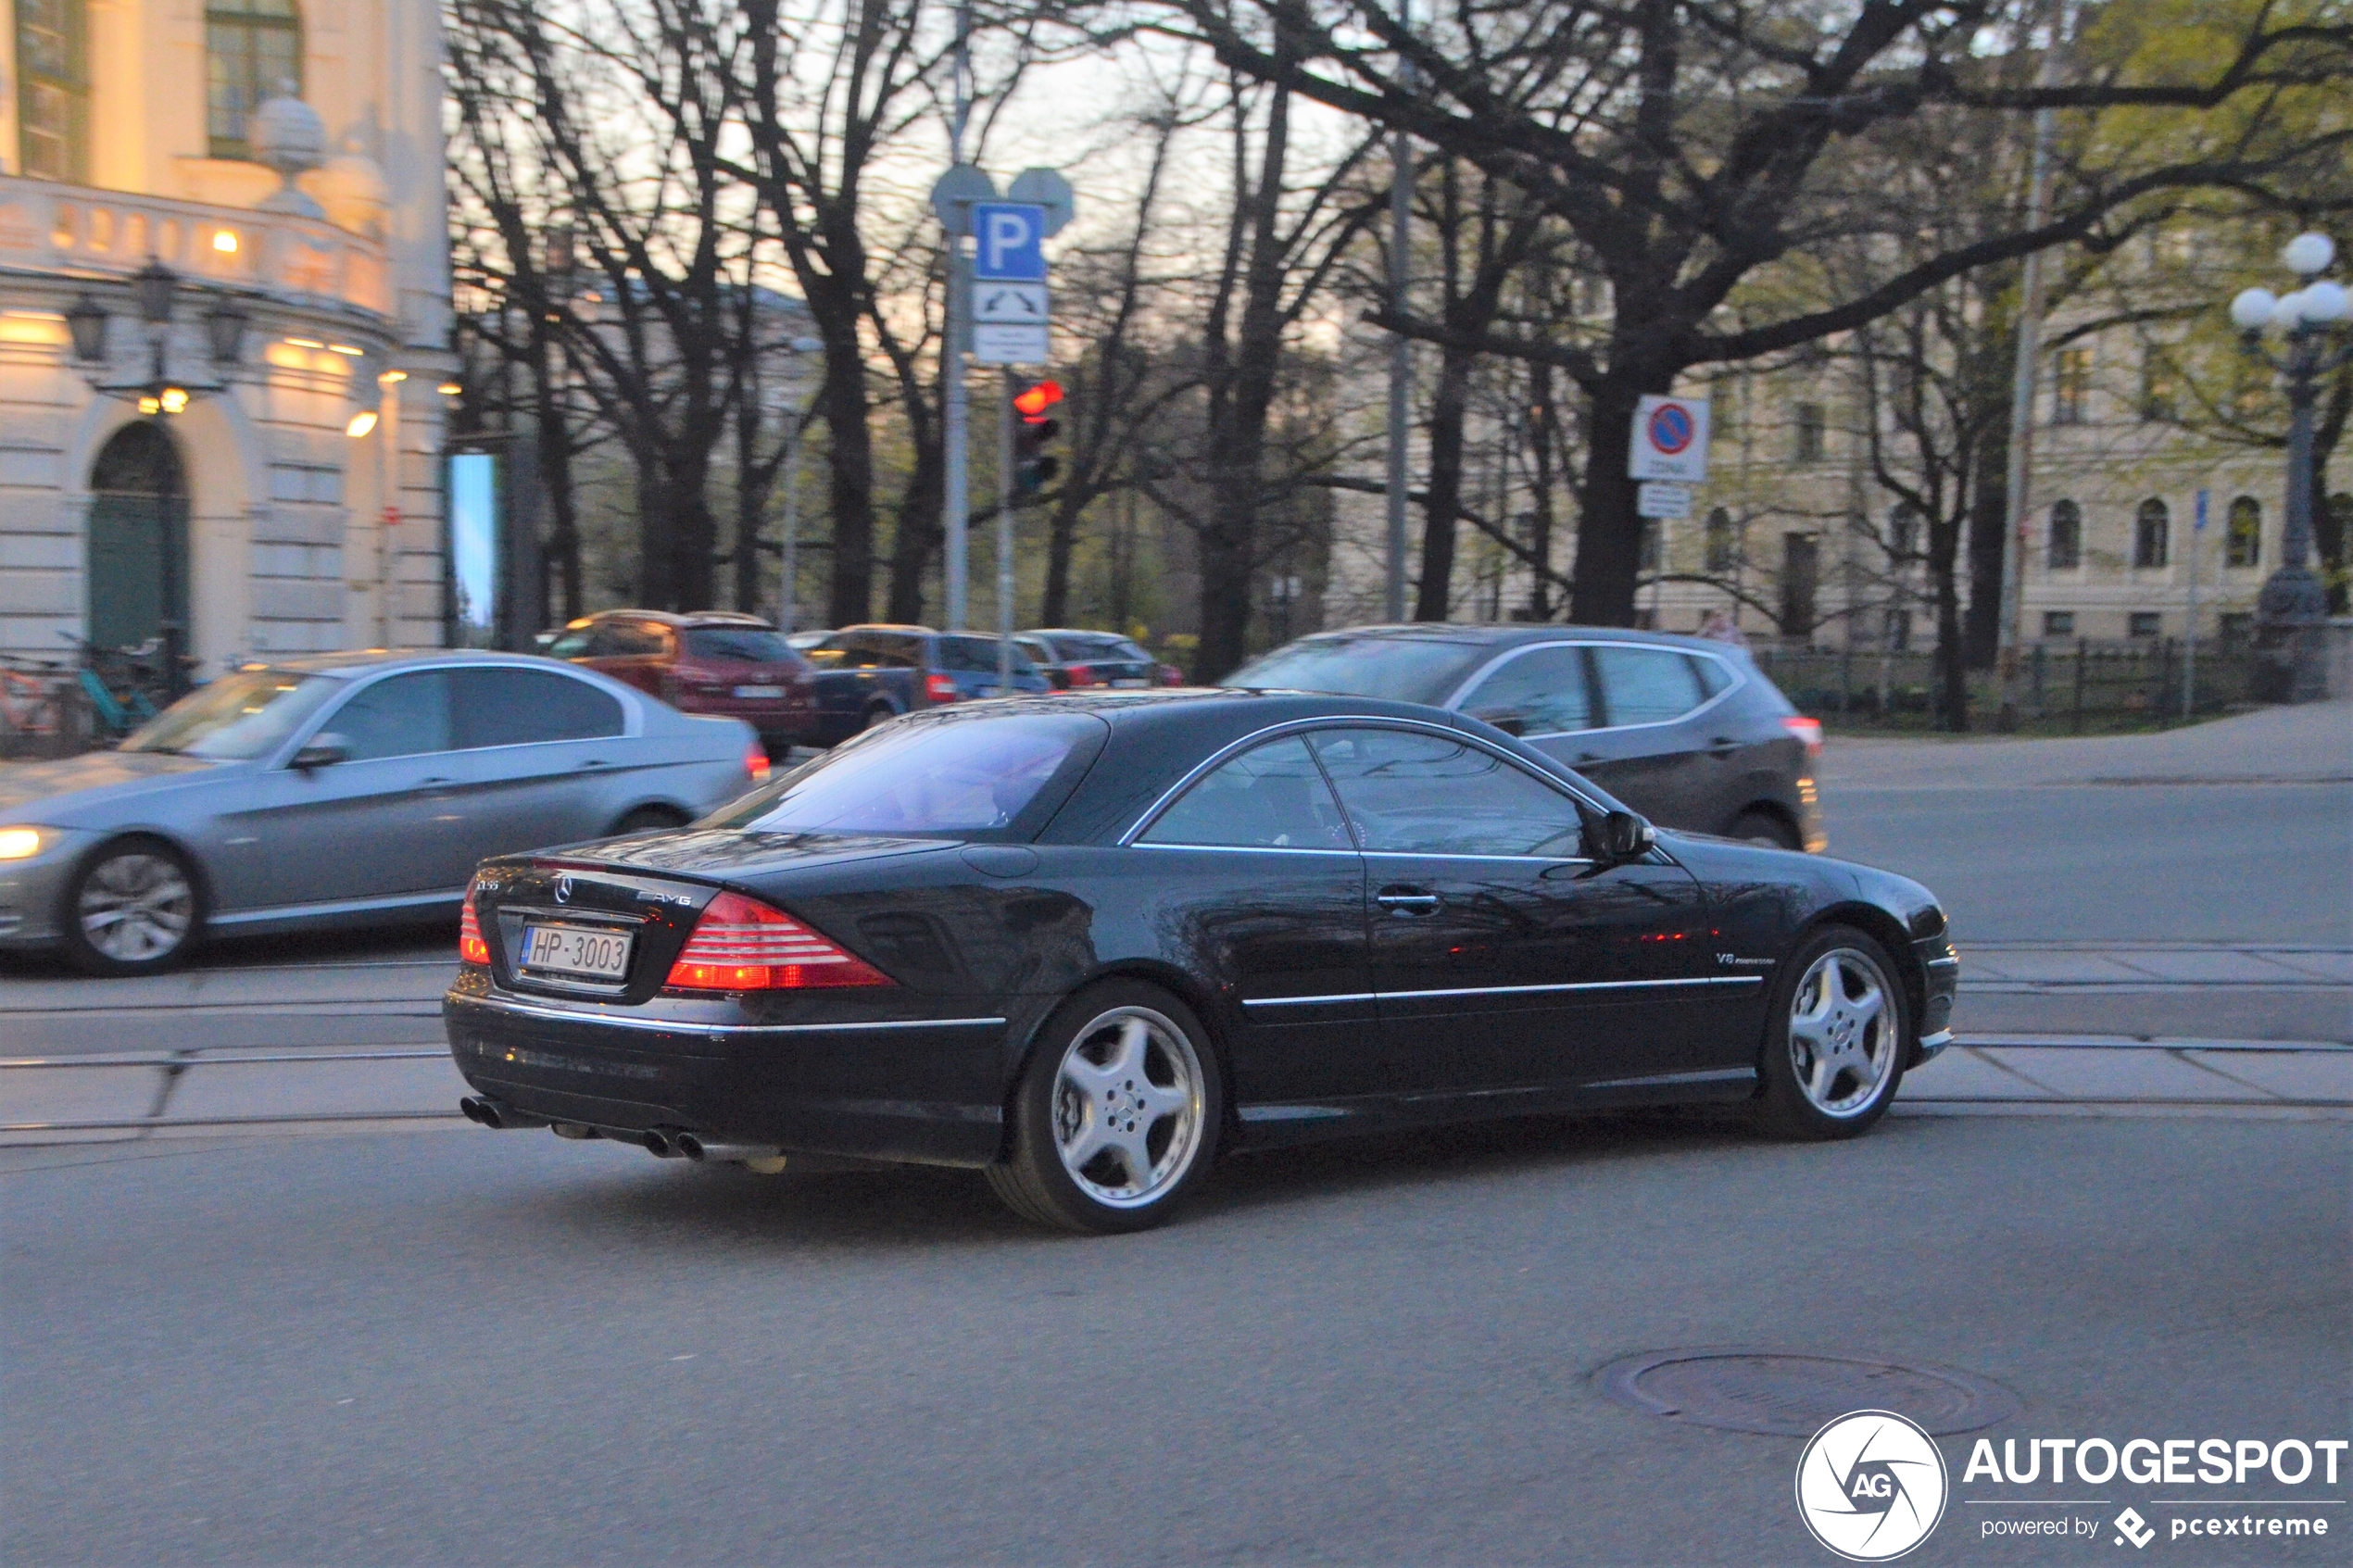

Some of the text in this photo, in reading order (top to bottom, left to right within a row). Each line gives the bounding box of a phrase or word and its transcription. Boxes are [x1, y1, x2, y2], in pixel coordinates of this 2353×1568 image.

[990, 213, 1028, 270] P
[652, 893, 692, 906] AMG
[533, 932, 624, 971] HP-3003
[1716, 952, 1735, 964] V8
